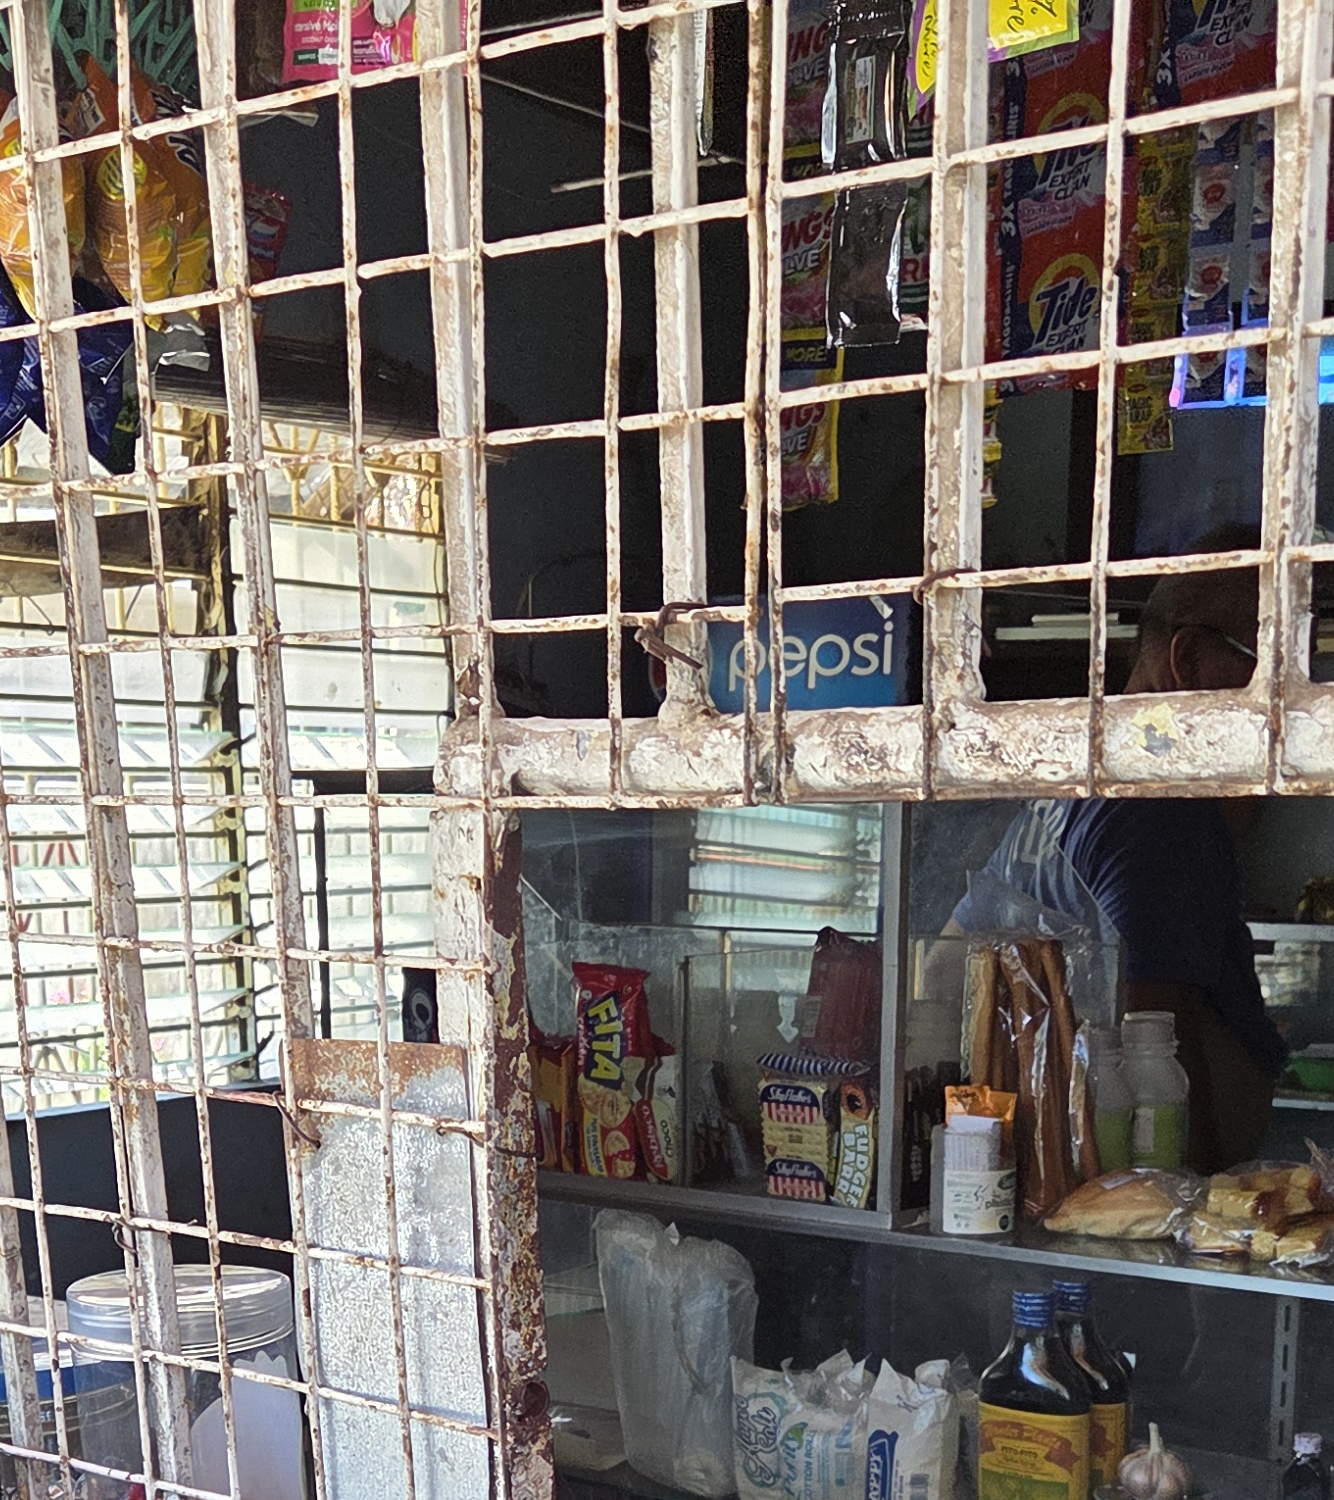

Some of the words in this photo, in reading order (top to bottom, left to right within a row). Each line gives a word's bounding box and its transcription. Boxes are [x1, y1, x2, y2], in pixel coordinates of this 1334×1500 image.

[1035, 276, 1098, 345] Tide
[729, 620, 894, 692] pepsi
[588, 997, 624, 1081] FITA
[835, 1131, 857, 1195] BARR
[845, 1124, 870, 1209] FUDGEE
